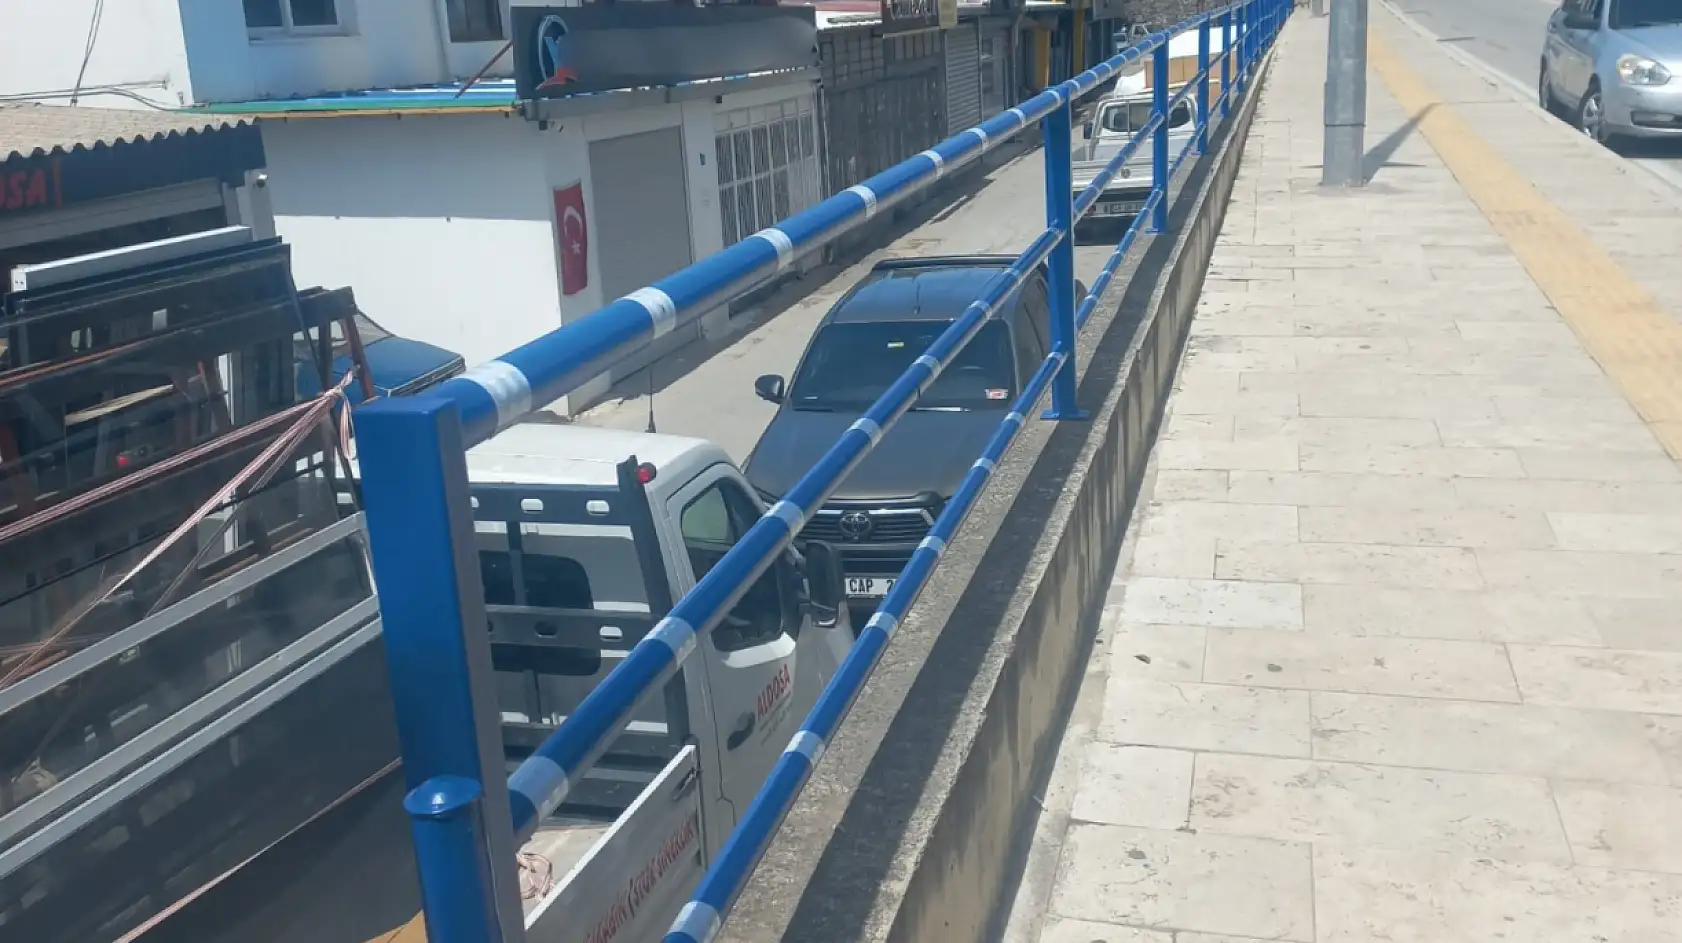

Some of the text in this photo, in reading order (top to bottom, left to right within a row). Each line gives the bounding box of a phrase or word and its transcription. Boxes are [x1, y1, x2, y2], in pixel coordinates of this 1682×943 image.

[0, 168, 48, 209] SA
[849, 579, 873, 593] CAP
[757, 663, 790, 721] ALDOSA
